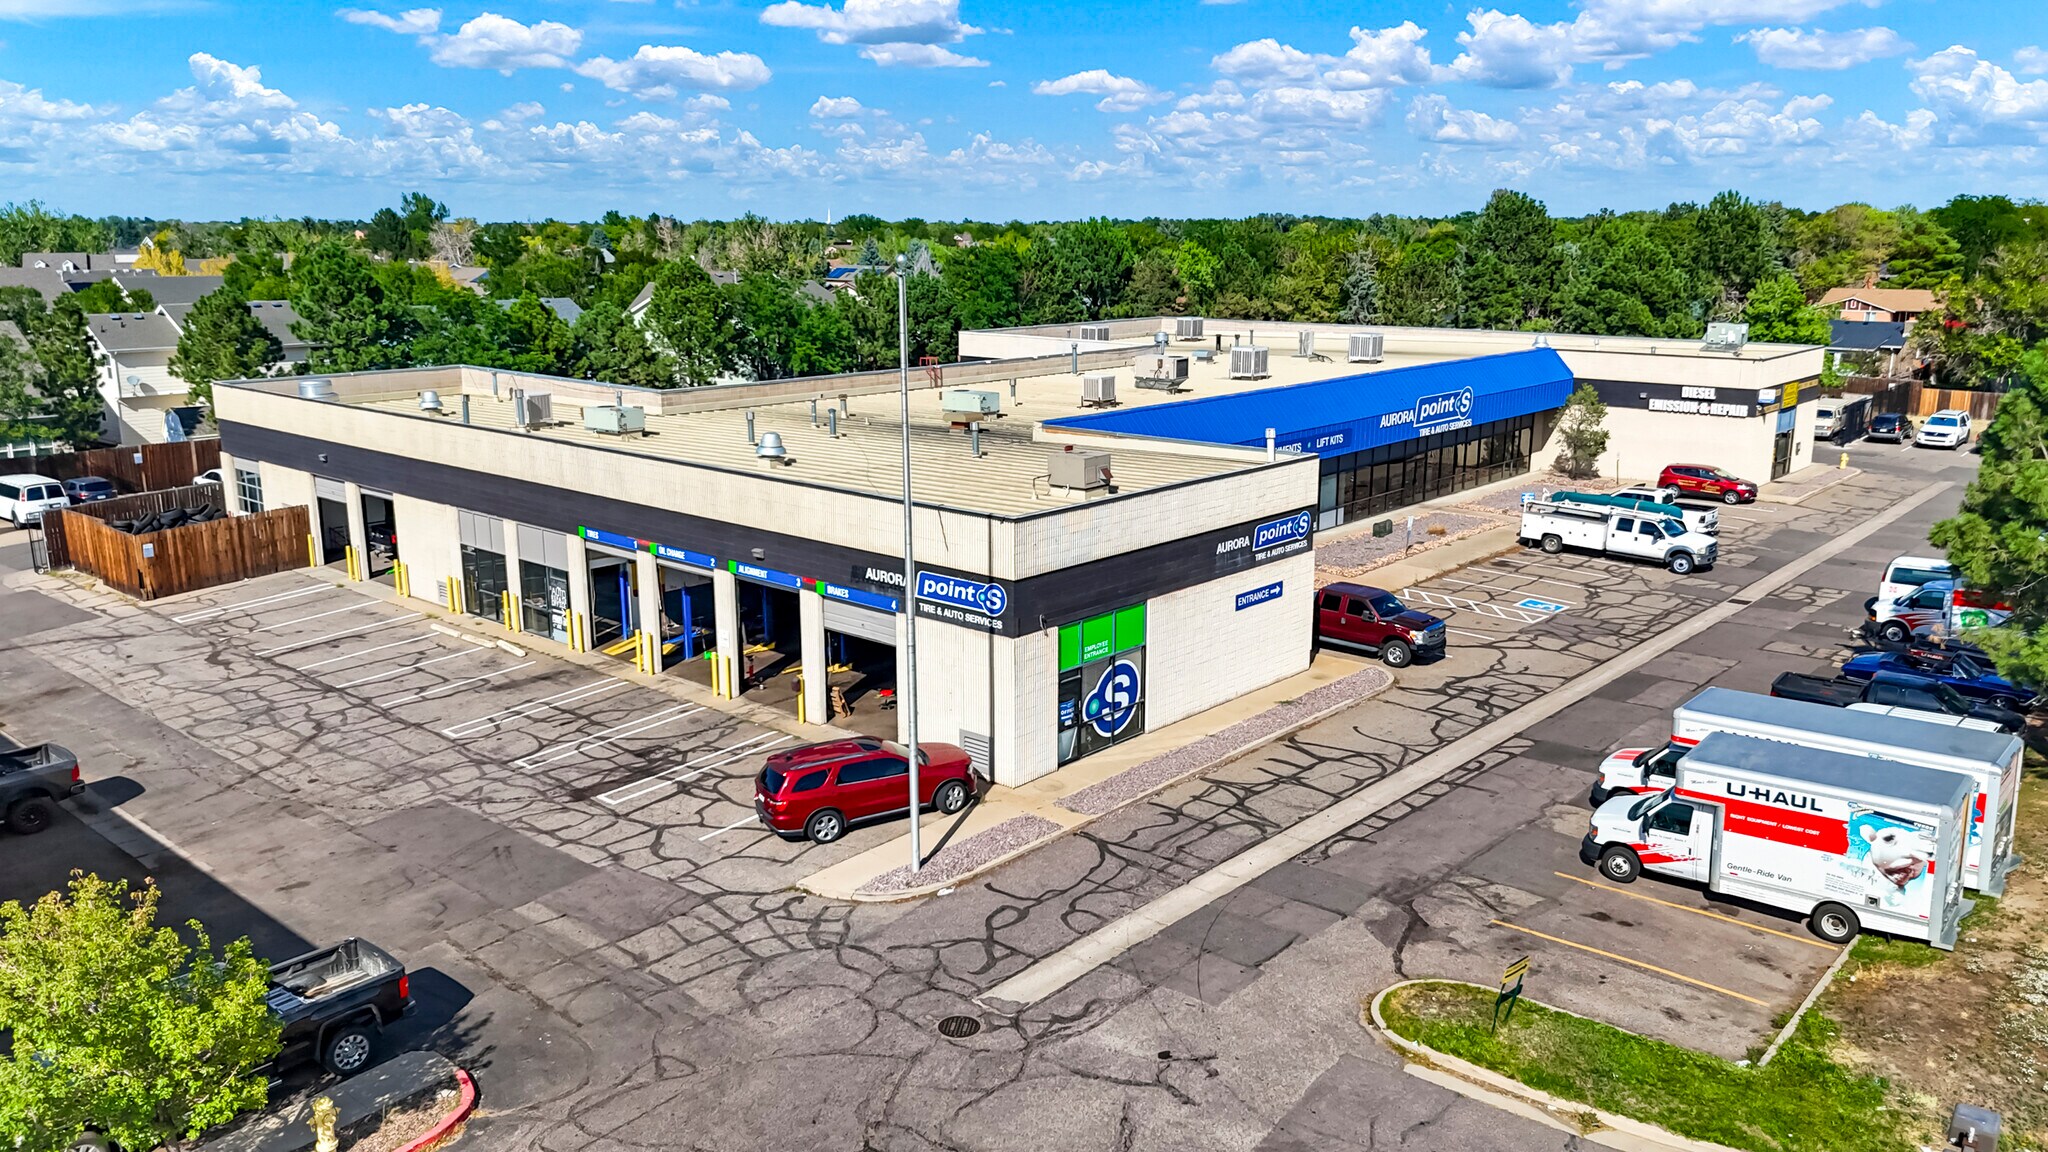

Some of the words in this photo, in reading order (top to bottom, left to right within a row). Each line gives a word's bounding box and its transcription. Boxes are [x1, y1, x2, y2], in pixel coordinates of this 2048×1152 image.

[1681, 386, 1716, 400] DIESEL
[1380, 410, 1415, 428] AURORA
[1420, 396, 1455, 421] point
[1648, 398, 1697, 413] EMISSION
[1698, 402, 1710, 415] &
[1710, 403, 1749, 417] REPAIR
[1419, 427, 1431, 437] TIRE
[1435, 423, 1449, 433] AUTO
[1449, 418, 1473, 431] SERVICES
[1316, 436, 1330, 449] LIFT
[1330, 433, 1344, 446] KITS
[633, 540, 638, 549] 1
[1216, 535, 1251, 555] AURORA
[1259, 519, 1292, 545] point
[658, 545, 666, 556] OIL
[666, 547, 686, 560] CHANGE
[1254, 551, 1267, 562] TIRE
[1271, 546, 1285, 557] AUTO
[1285, 539, 1308, 552] SERVICES
[710, 557, 716, 567] 2
[738, 564, 768, 579] ALIGNMENT
[795, 577, 801, 587] 3
[826, 585, 849, 599] BRAKES
[923, 579, 975, 602] point
[1238, 588, 1270, 607] ENTRANCE
[890, 600, 897, 610] 4
[919, 602, 936, 614] TIRE
[937, 606, 943, 616] &
[943, 608, 964, 622] AUTO
[965, 613, 1003, 630] SERVICES
[1083, 646, 1109, 660] ENTRANCE
[1084, 640, 1109, 653] EMPLOYEE
[1727, 782, 1823, 812] U-HAUL
[1729, 813, 1746, 821] RIGHT
[1746, 816, 1778, 827] EQUIPMENT
[1782, 823, 1804, 833] LOWEST
[1804, 828, 1821, 836] COST
[1777, 873, 1793, 883] Van
